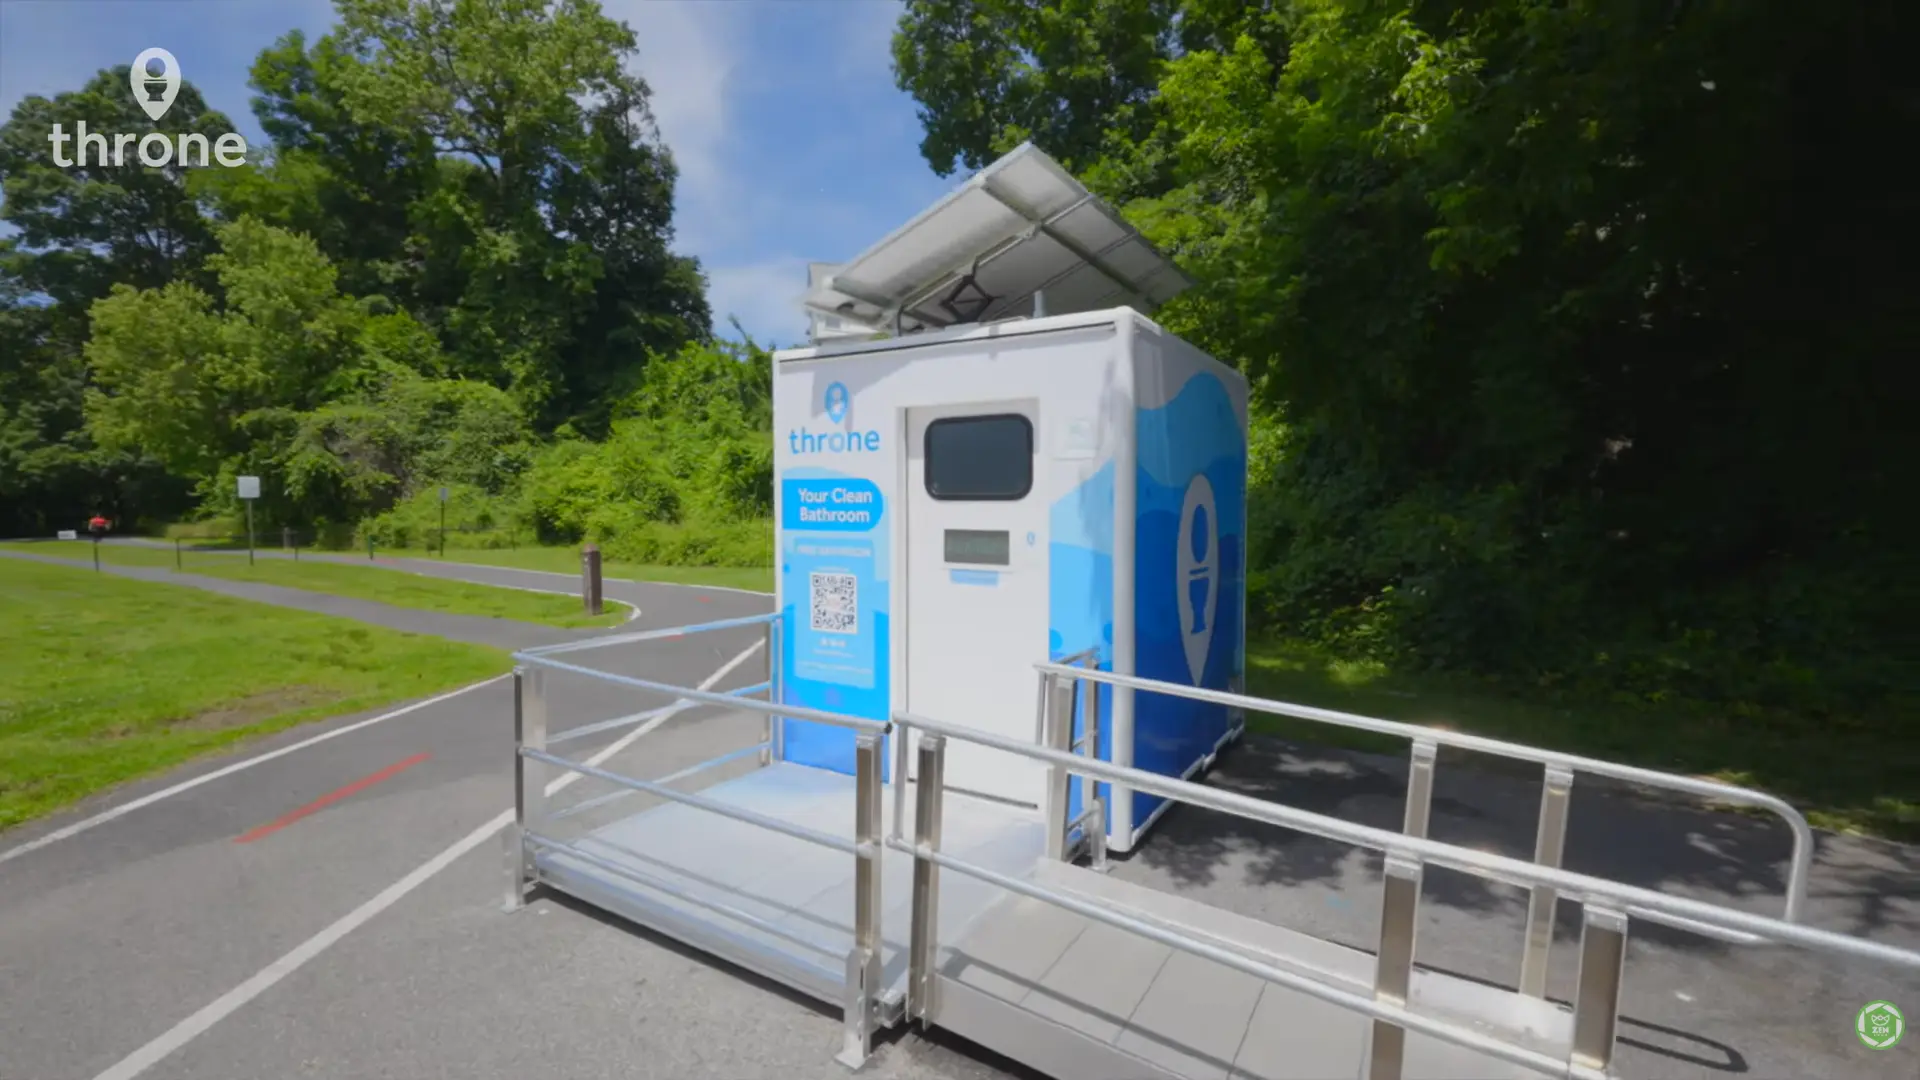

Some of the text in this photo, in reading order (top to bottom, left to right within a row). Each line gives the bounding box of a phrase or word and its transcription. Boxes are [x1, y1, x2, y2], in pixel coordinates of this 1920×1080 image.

[789, 426, 880, 454] throne
[798, 487, 873, 503] Your Clean
[800, 506, 871, 523] Bathroom
